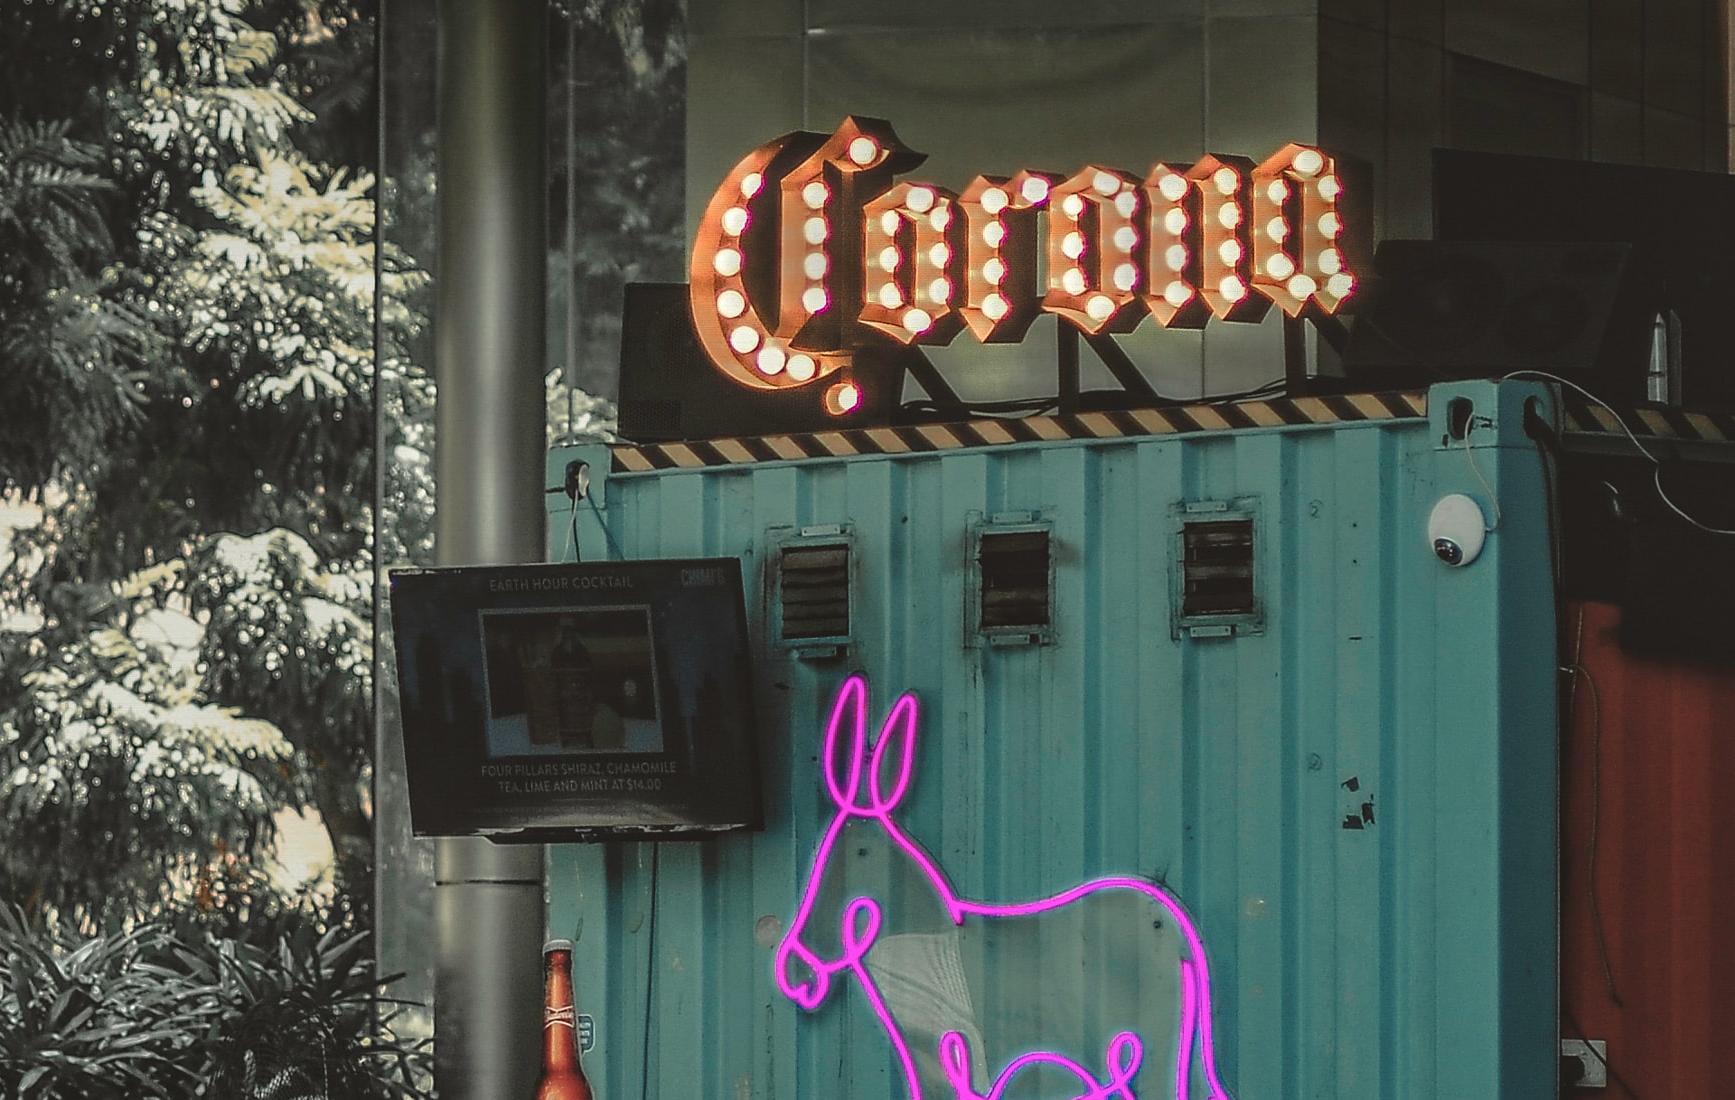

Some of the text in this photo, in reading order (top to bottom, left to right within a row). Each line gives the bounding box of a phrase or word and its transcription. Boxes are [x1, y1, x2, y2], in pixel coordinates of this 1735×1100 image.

[690, 115, 1369, 416] Corona
[489, 575, 634, 592] EARTH HOUR COCKTAIL
[481, 764, 512, 777] FOUR
[515, 763, 558, 776] PILLARS
[607, 760, 677, 775] CHAMOMILE
[525, 780, 551, 793] LIME
[553, 779, 578, 792] AND
[581, 779, 609, 792] MINT
[611, 778, 625, 791] AT
